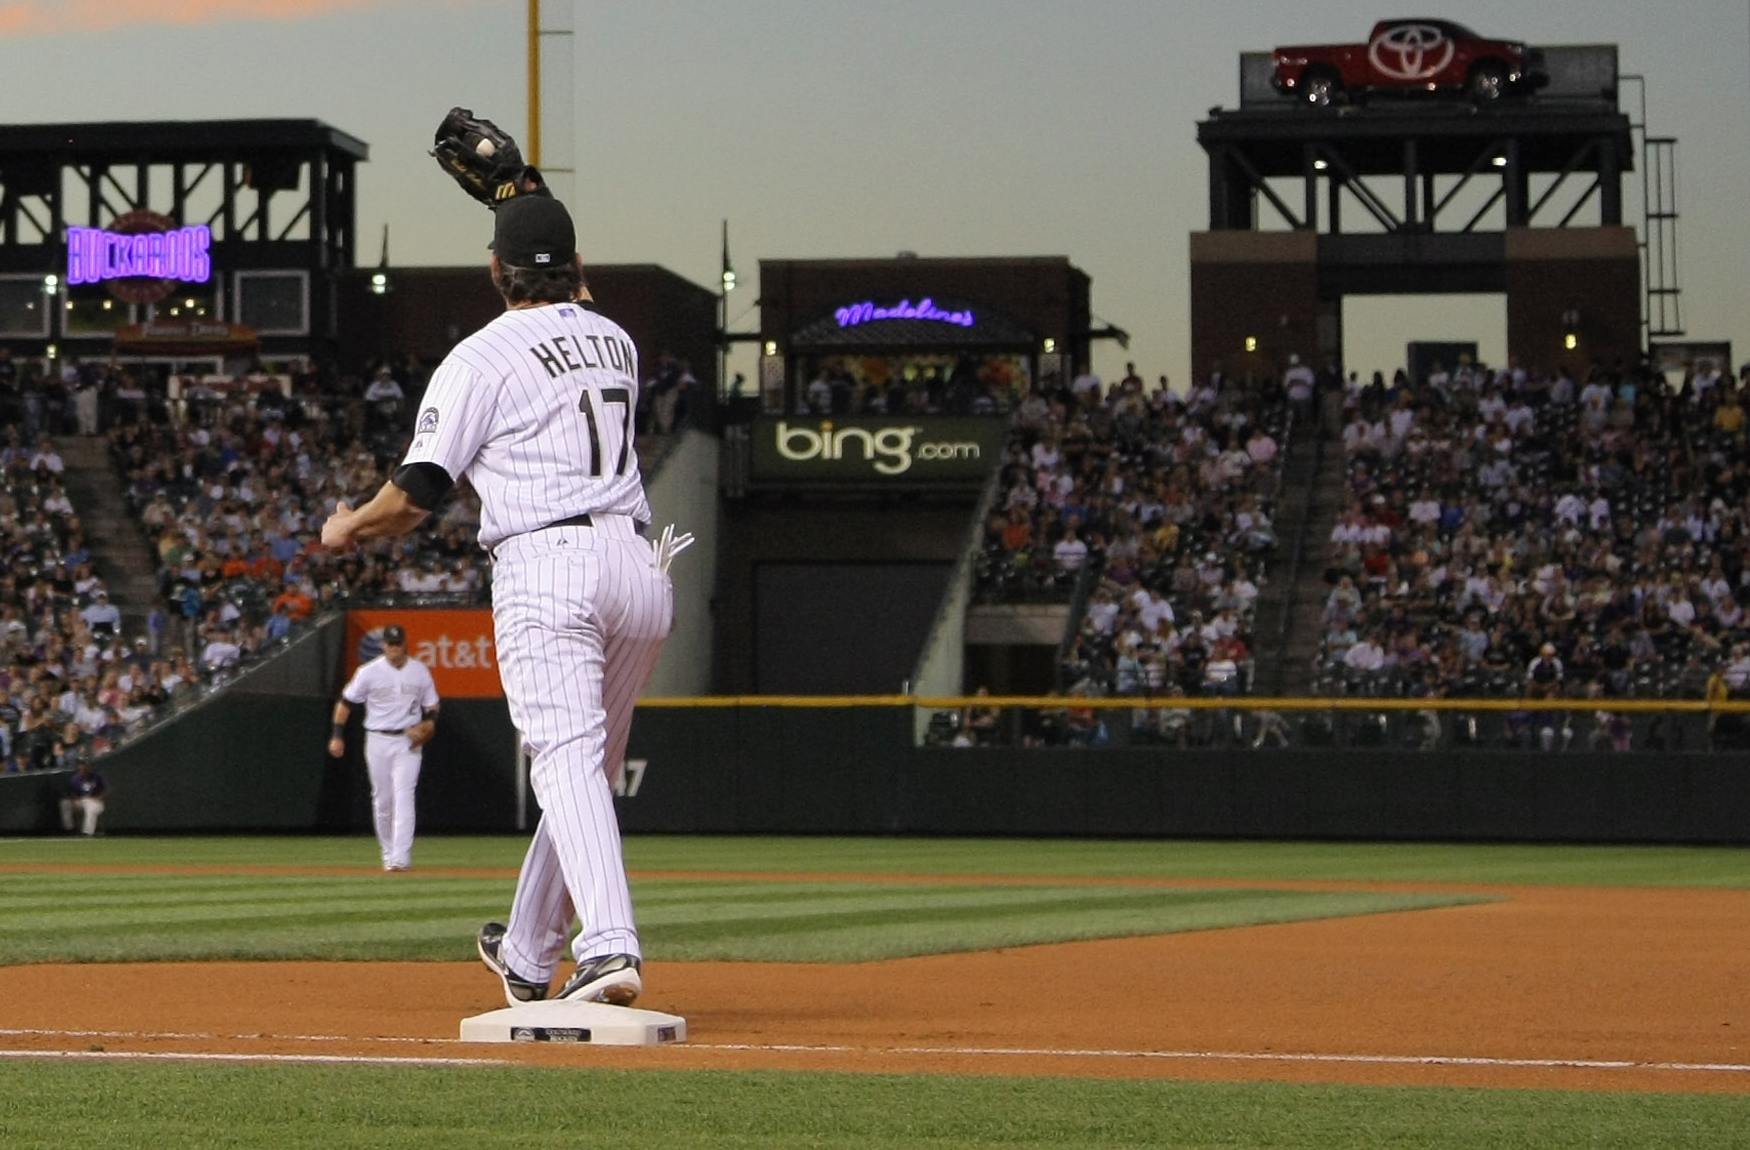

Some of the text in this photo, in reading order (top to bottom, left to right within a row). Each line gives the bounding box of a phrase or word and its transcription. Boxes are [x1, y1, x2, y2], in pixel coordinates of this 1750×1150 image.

[66, 224, 210, 286] BUCKAROOS
[529, 334, 635, 379] HELTON
[578, 388, 631, 477] 17
[415, 633, 493, 669] at&t
